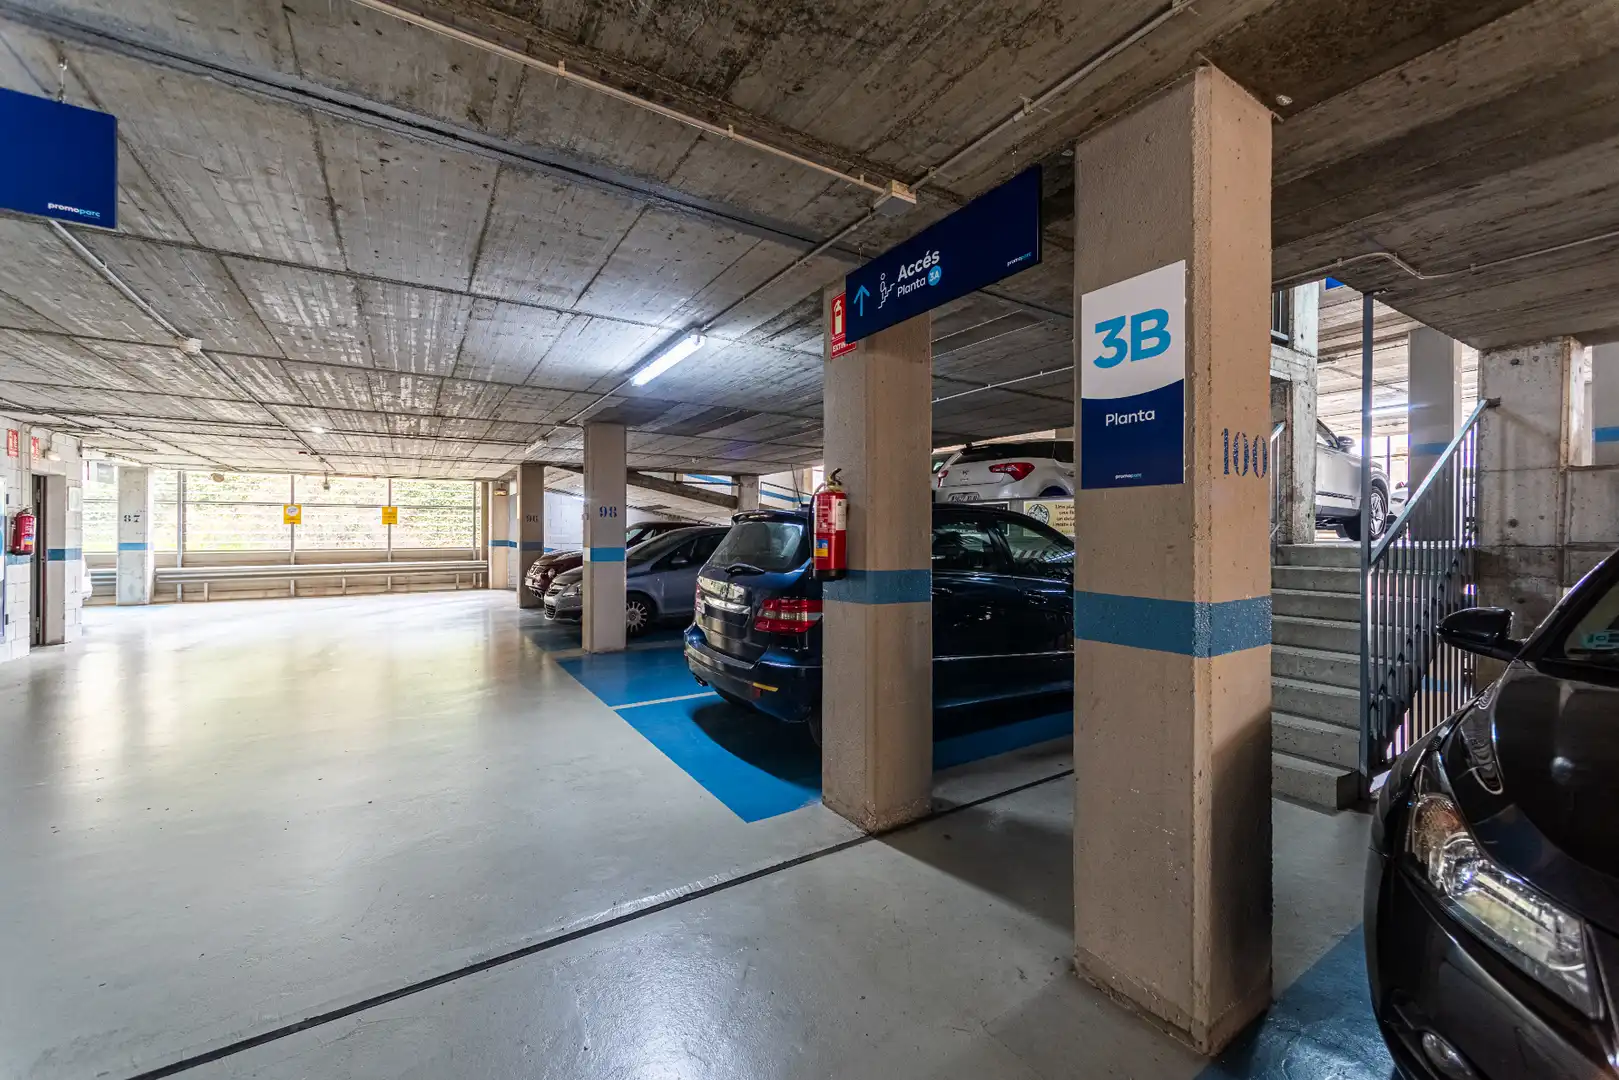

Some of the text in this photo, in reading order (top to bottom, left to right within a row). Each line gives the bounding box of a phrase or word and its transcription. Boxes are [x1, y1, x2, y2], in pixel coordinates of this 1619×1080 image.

[47, 202, 101, 217] promoparc
[897, 249, 940, 283] Accés
[897, 270, 940, 298] Planta 3A
[1093, 308, 1171, 369] 3B
[1105, 409, 1155, 427] Planta
[1221, 428, 1267, 478] 100
[124, 514, 141, 523] 87
[599, 506, 617, 518] 98
